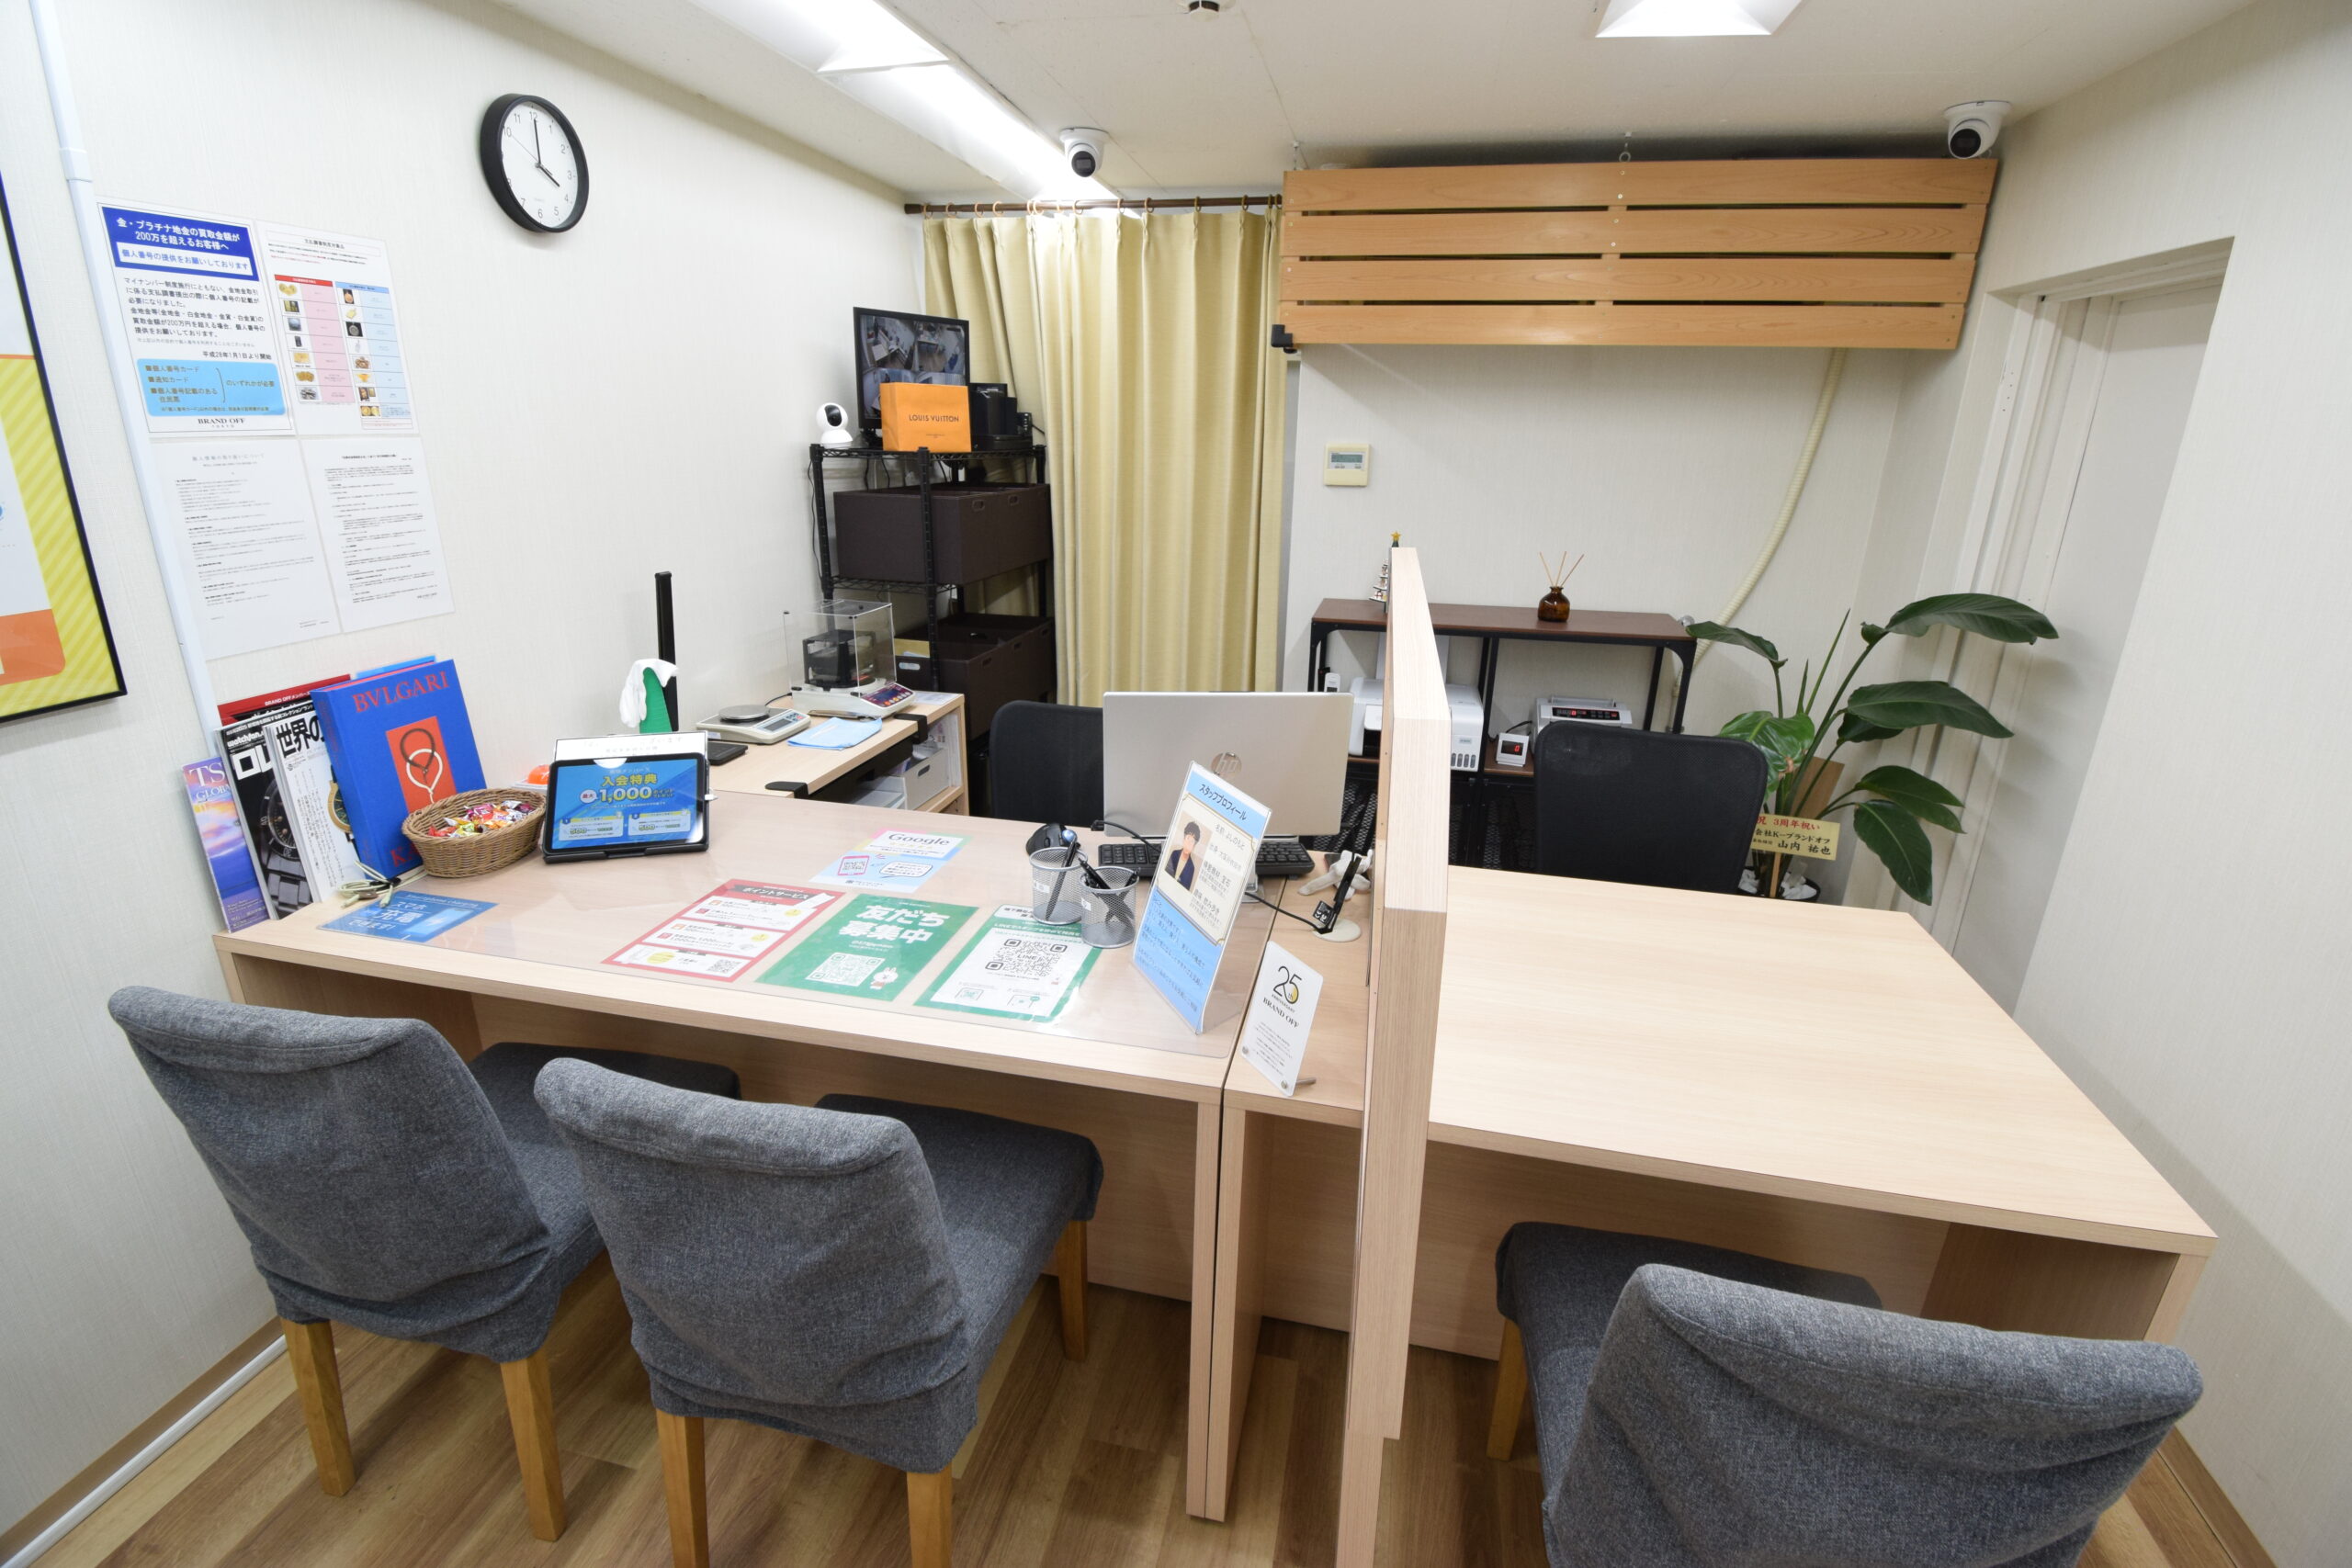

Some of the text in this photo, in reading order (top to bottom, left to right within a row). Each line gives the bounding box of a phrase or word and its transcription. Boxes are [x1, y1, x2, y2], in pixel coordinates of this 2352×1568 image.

[514, 113, 521, 124] 11
[529, 111, 538, 122] 12
[135, 231, 230, 251] 200万を超えるお客様へ
[352, 671, 450, 713] BVLGARI
[602, 773, 657, 787] 入会特典
[599, 786, 653, 804] 1,000
[1199, 784, 1248, 821] スタッフプロフィール
[1773, 818, 1820, 830] 3周年祝い
[888, 833, 950, 847] Google
[1778, 840, 1801, 851] 山内
[742, 886, 810, 900] ポイントサービス
[374, 908, 424, 924] 充電
[856, 905, 951, 928] 友だち
[838, 920, 933, 944] 募集中
[1263, 997, 1299, 1028] BRAND OFF
